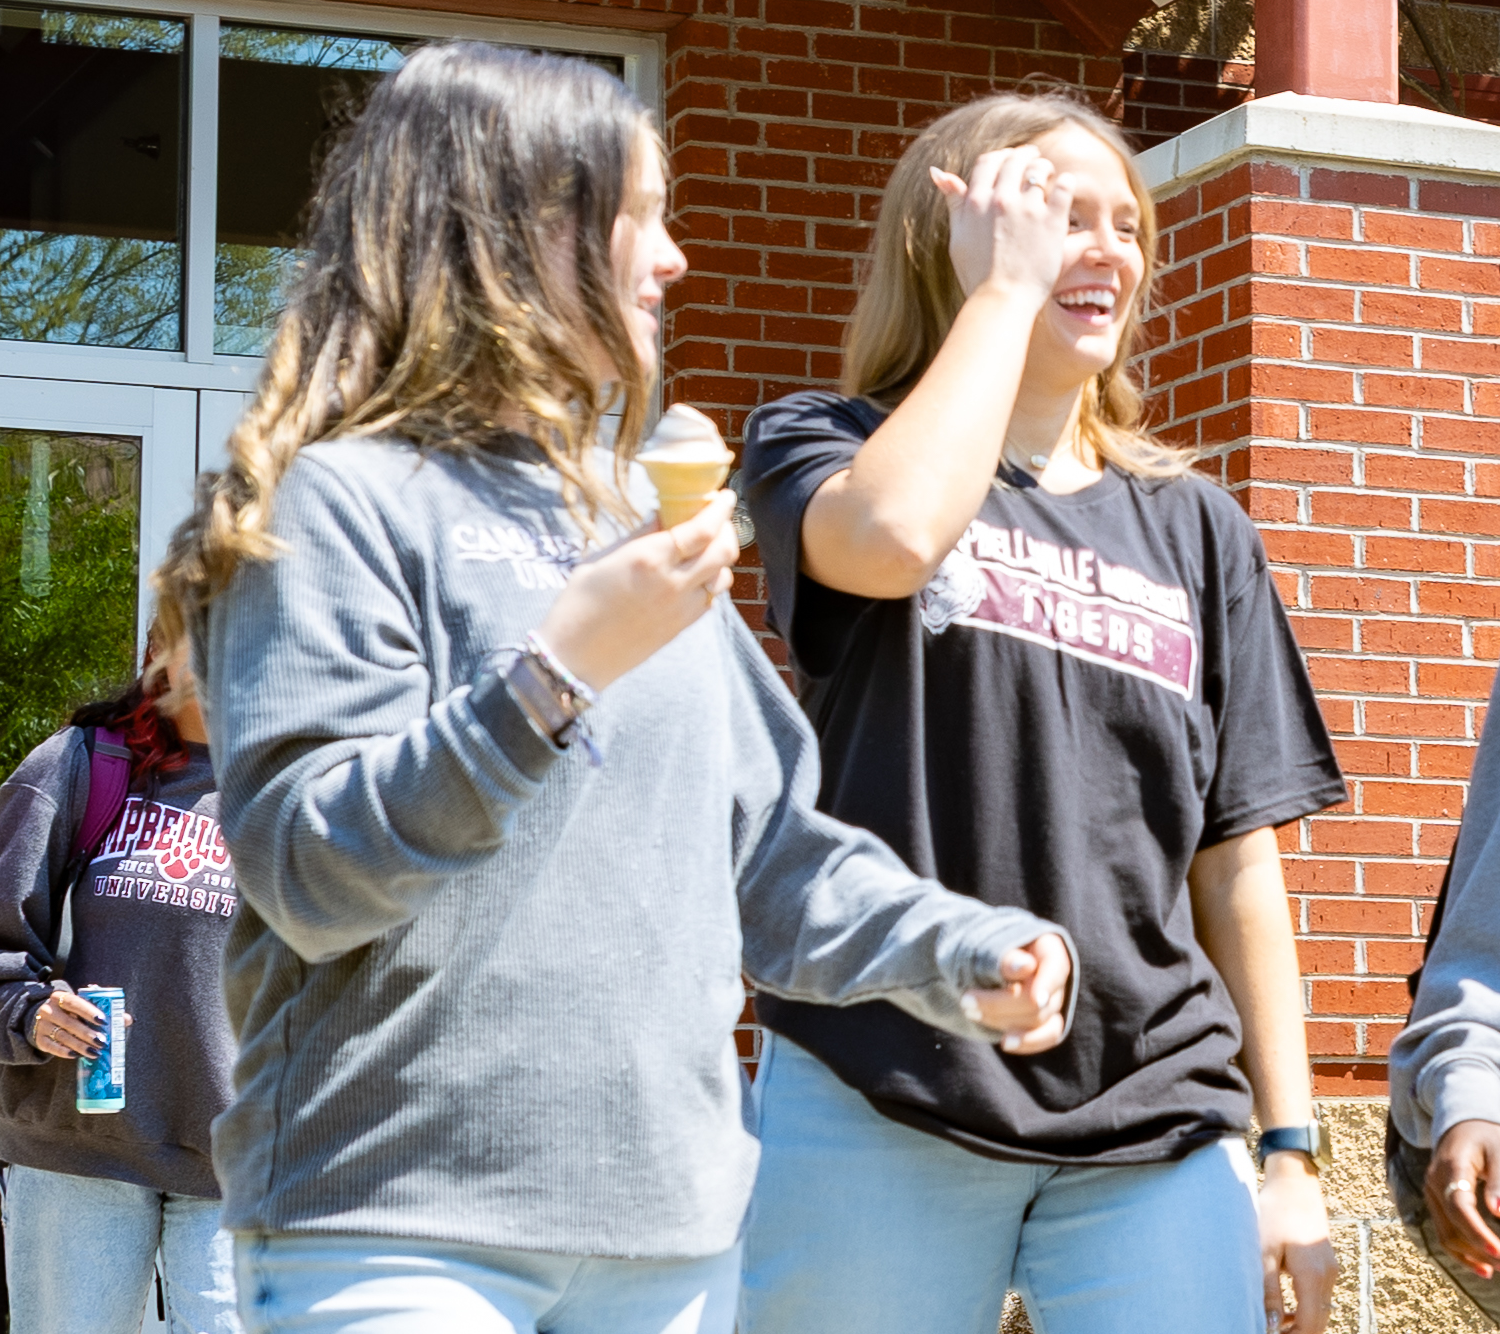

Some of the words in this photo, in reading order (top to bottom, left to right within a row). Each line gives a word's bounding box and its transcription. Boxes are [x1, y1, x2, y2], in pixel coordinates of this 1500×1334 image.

[1017, 585, 1154, 662] TIGERS
[117, 858, 155, 875] SINCE
[202, 872, 236, 889] 190
[93, 875, 238, 917] UNIVERSIT
